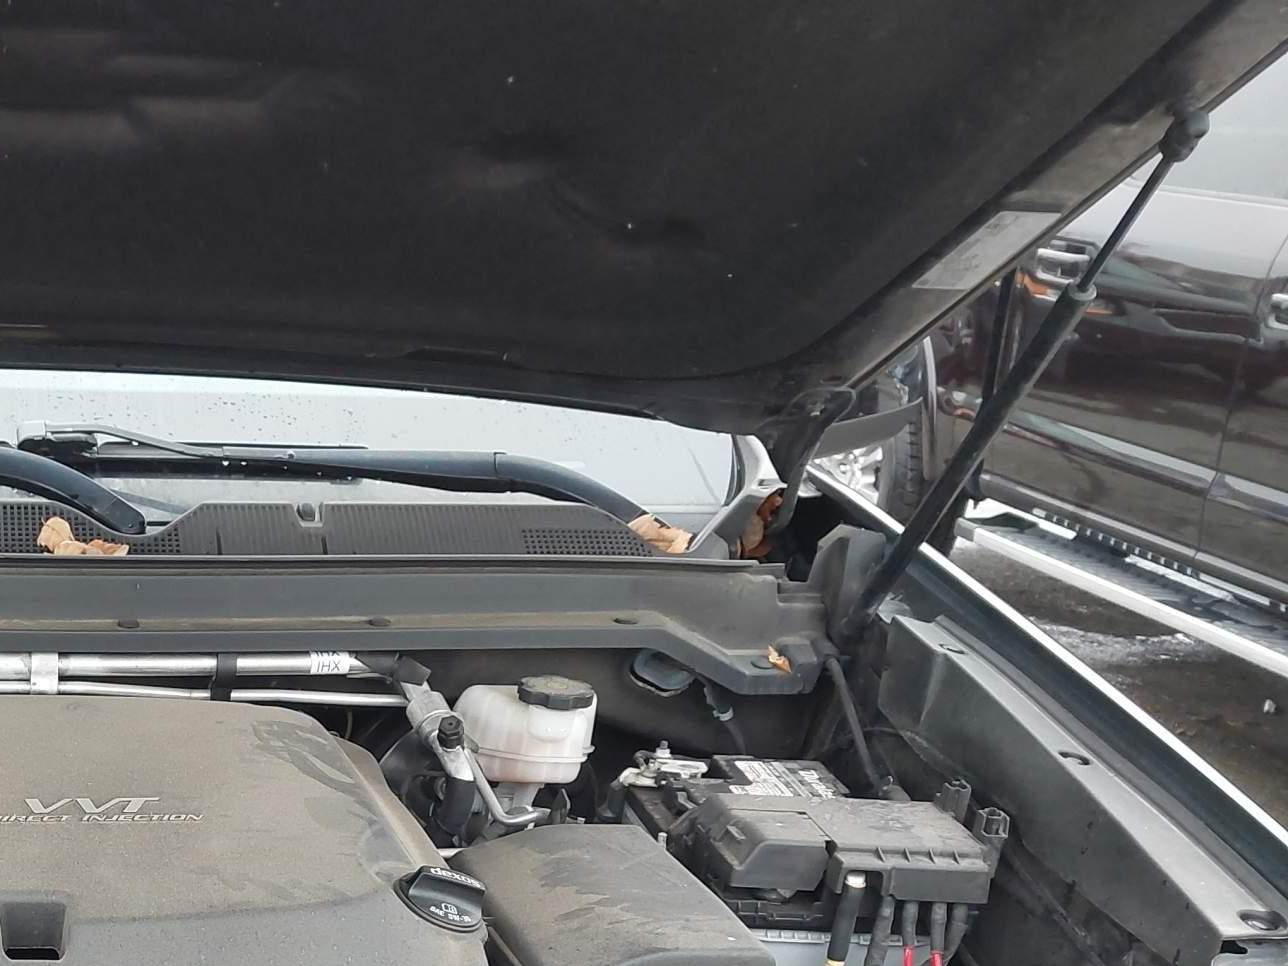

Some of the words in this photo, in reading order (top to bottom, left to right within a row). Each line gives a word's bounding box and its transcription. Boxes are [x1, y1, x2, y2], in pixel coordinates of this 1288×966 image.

[317, 660, 341, 672] IHX
[24, 797, 161, 814] VVT
[81, 813, 204, 823] INJECTION
[430, 867, 481, 888] dexos
